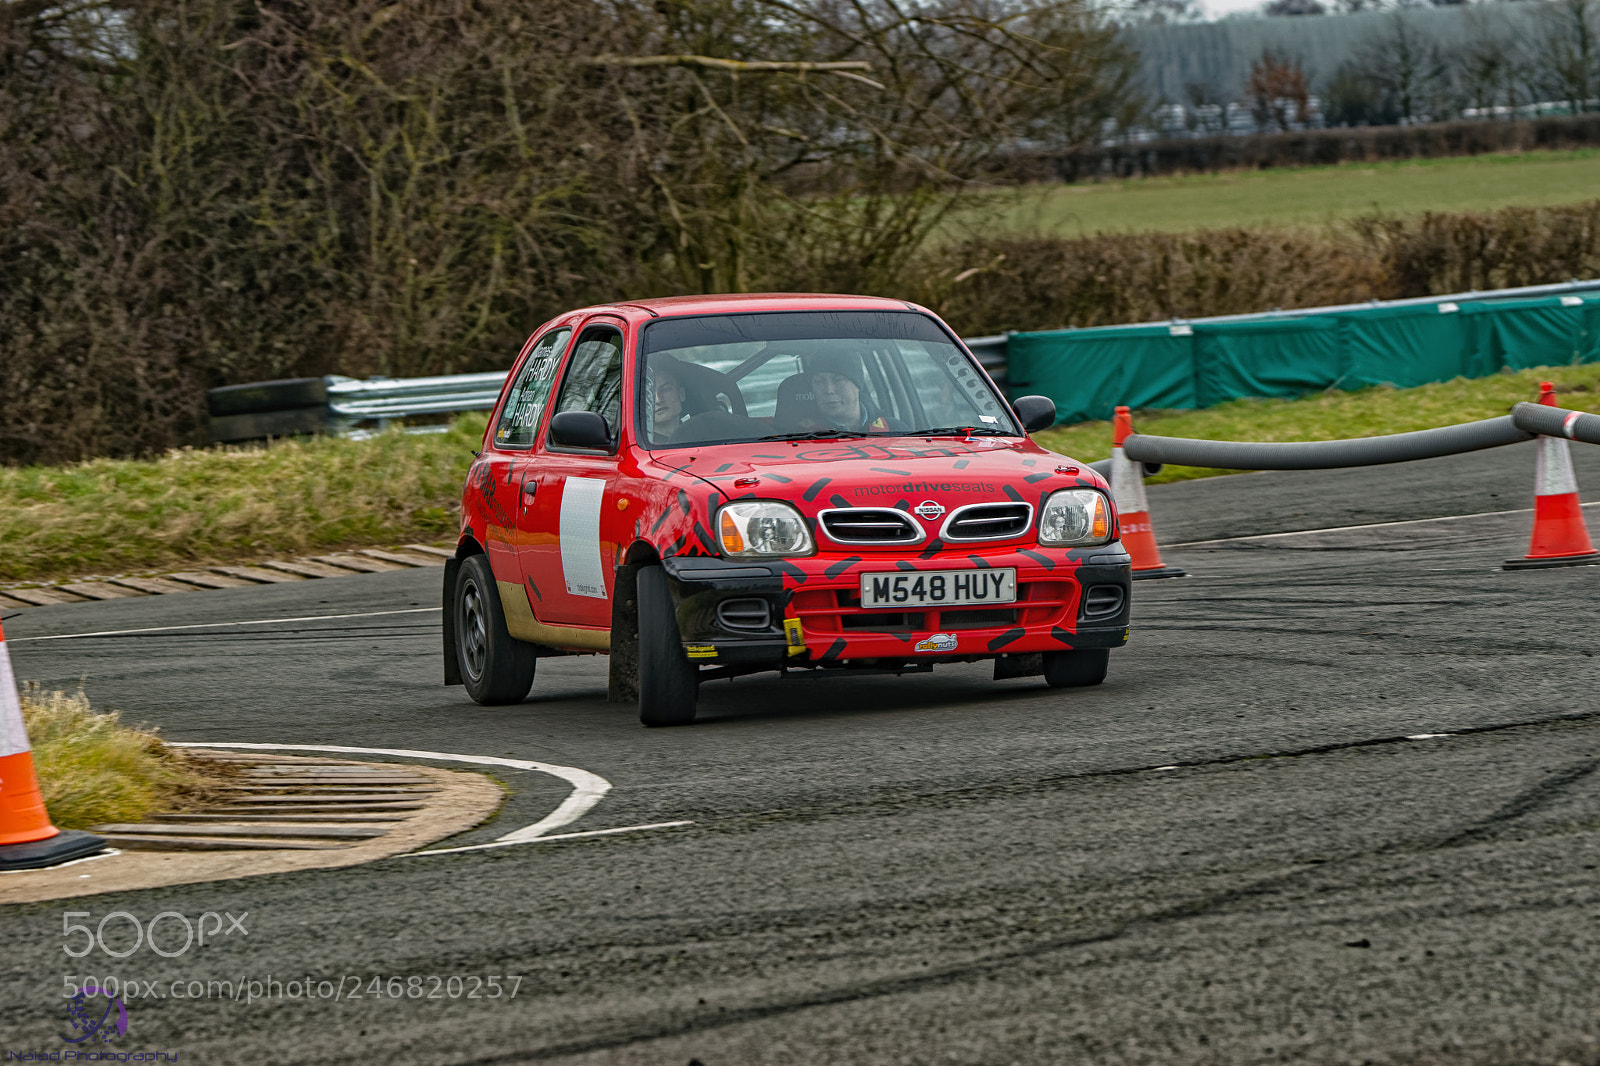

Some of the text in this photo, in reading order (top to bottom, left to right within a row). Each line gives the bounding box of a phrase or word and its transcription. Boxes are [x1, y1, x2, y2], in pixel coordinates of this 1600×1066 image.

[525, 357, 560, 382] HARDY
[512, 403, 545, 427] HARDY
[854, 481, 995, 497] motordriveseats
[918, 506, 943, 514] NISSAN
[872, 572, 1005, 603] M548 HUY
[918, 641, 957, 651] rallynuts
